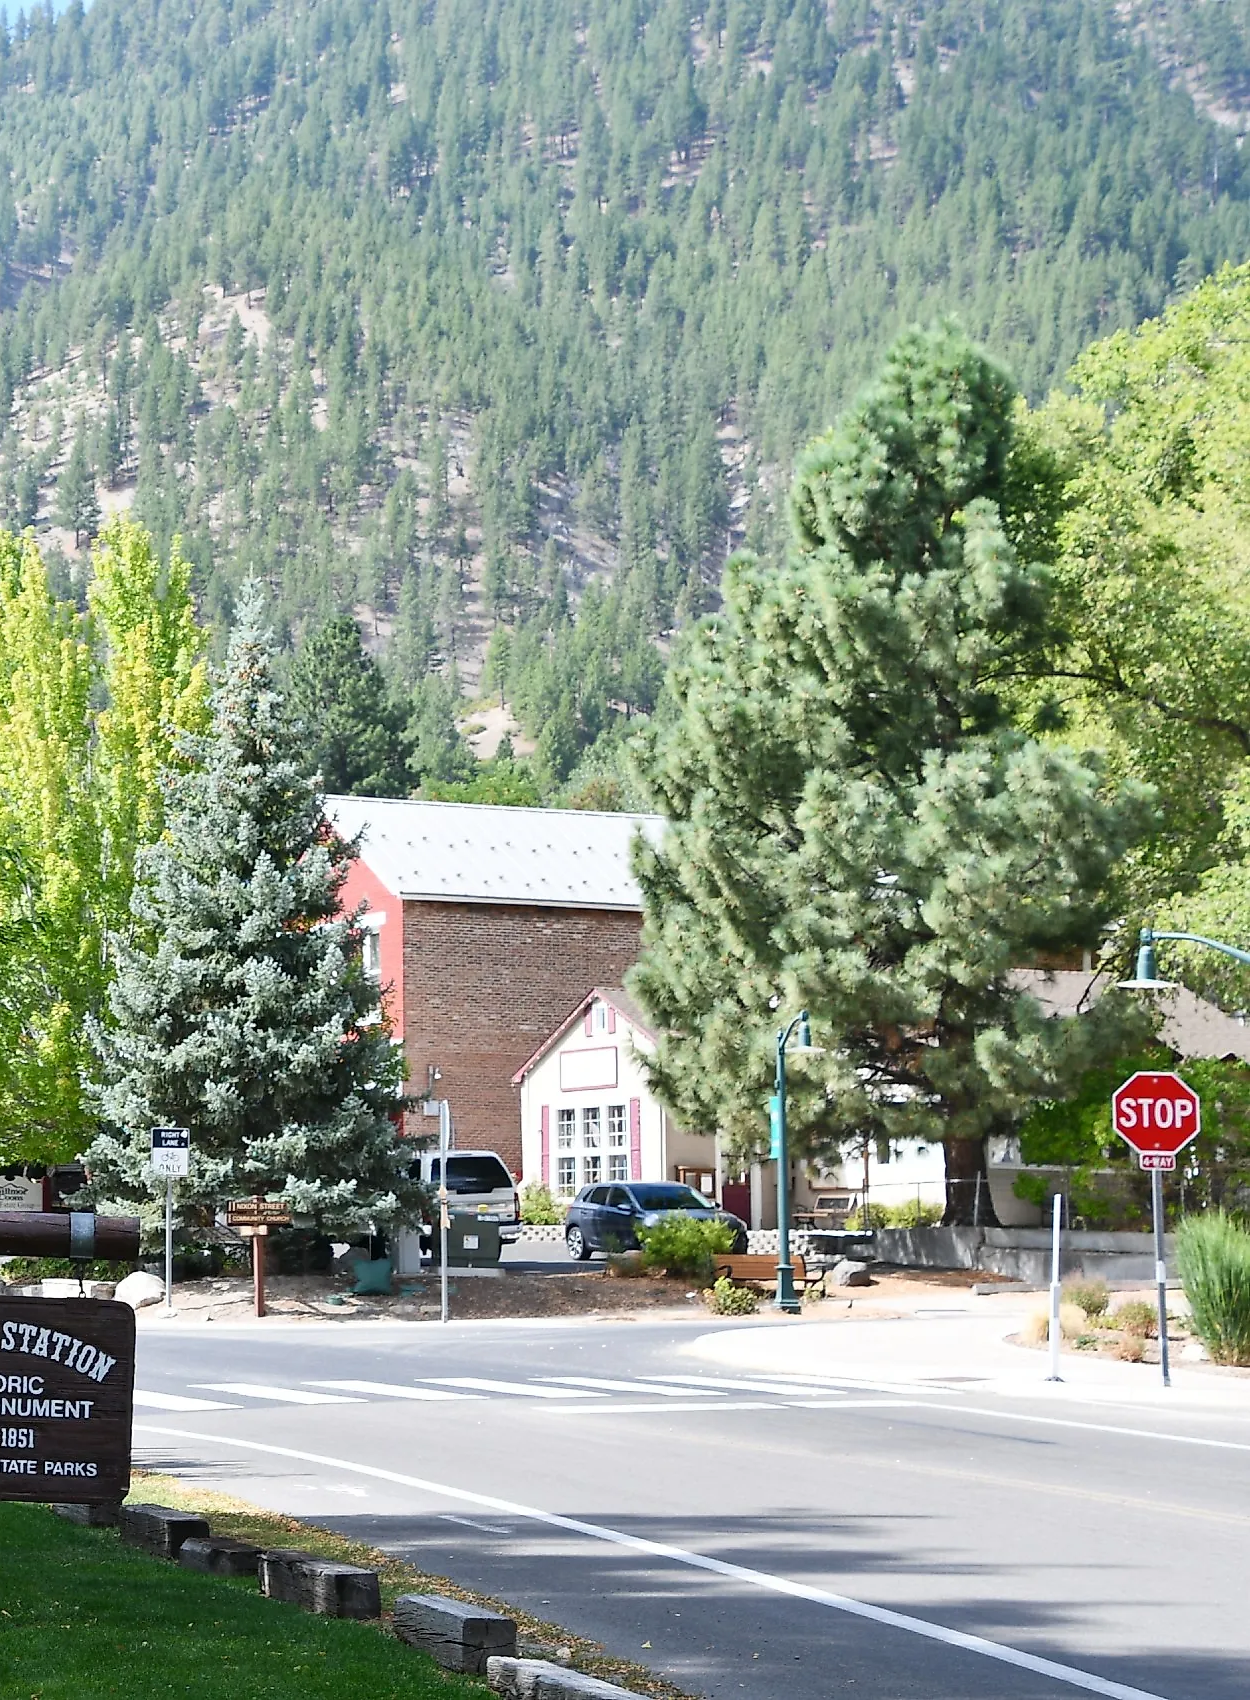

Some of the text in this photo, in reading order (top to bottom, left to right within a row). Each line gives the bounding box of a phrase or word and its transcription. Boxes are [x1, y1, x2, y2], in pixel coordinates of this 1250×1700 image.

[1119, 1097, 1193, 1129] STOP
[161, 1139, 179, 1147] LANE
[159, 1163, 182, 1173] ONLY
[1143, 1157, 1172, 1167] 4-WAY
[0, 1321, 117, 1383] STATION
[44, 1461, 98, 1477] PARKS
